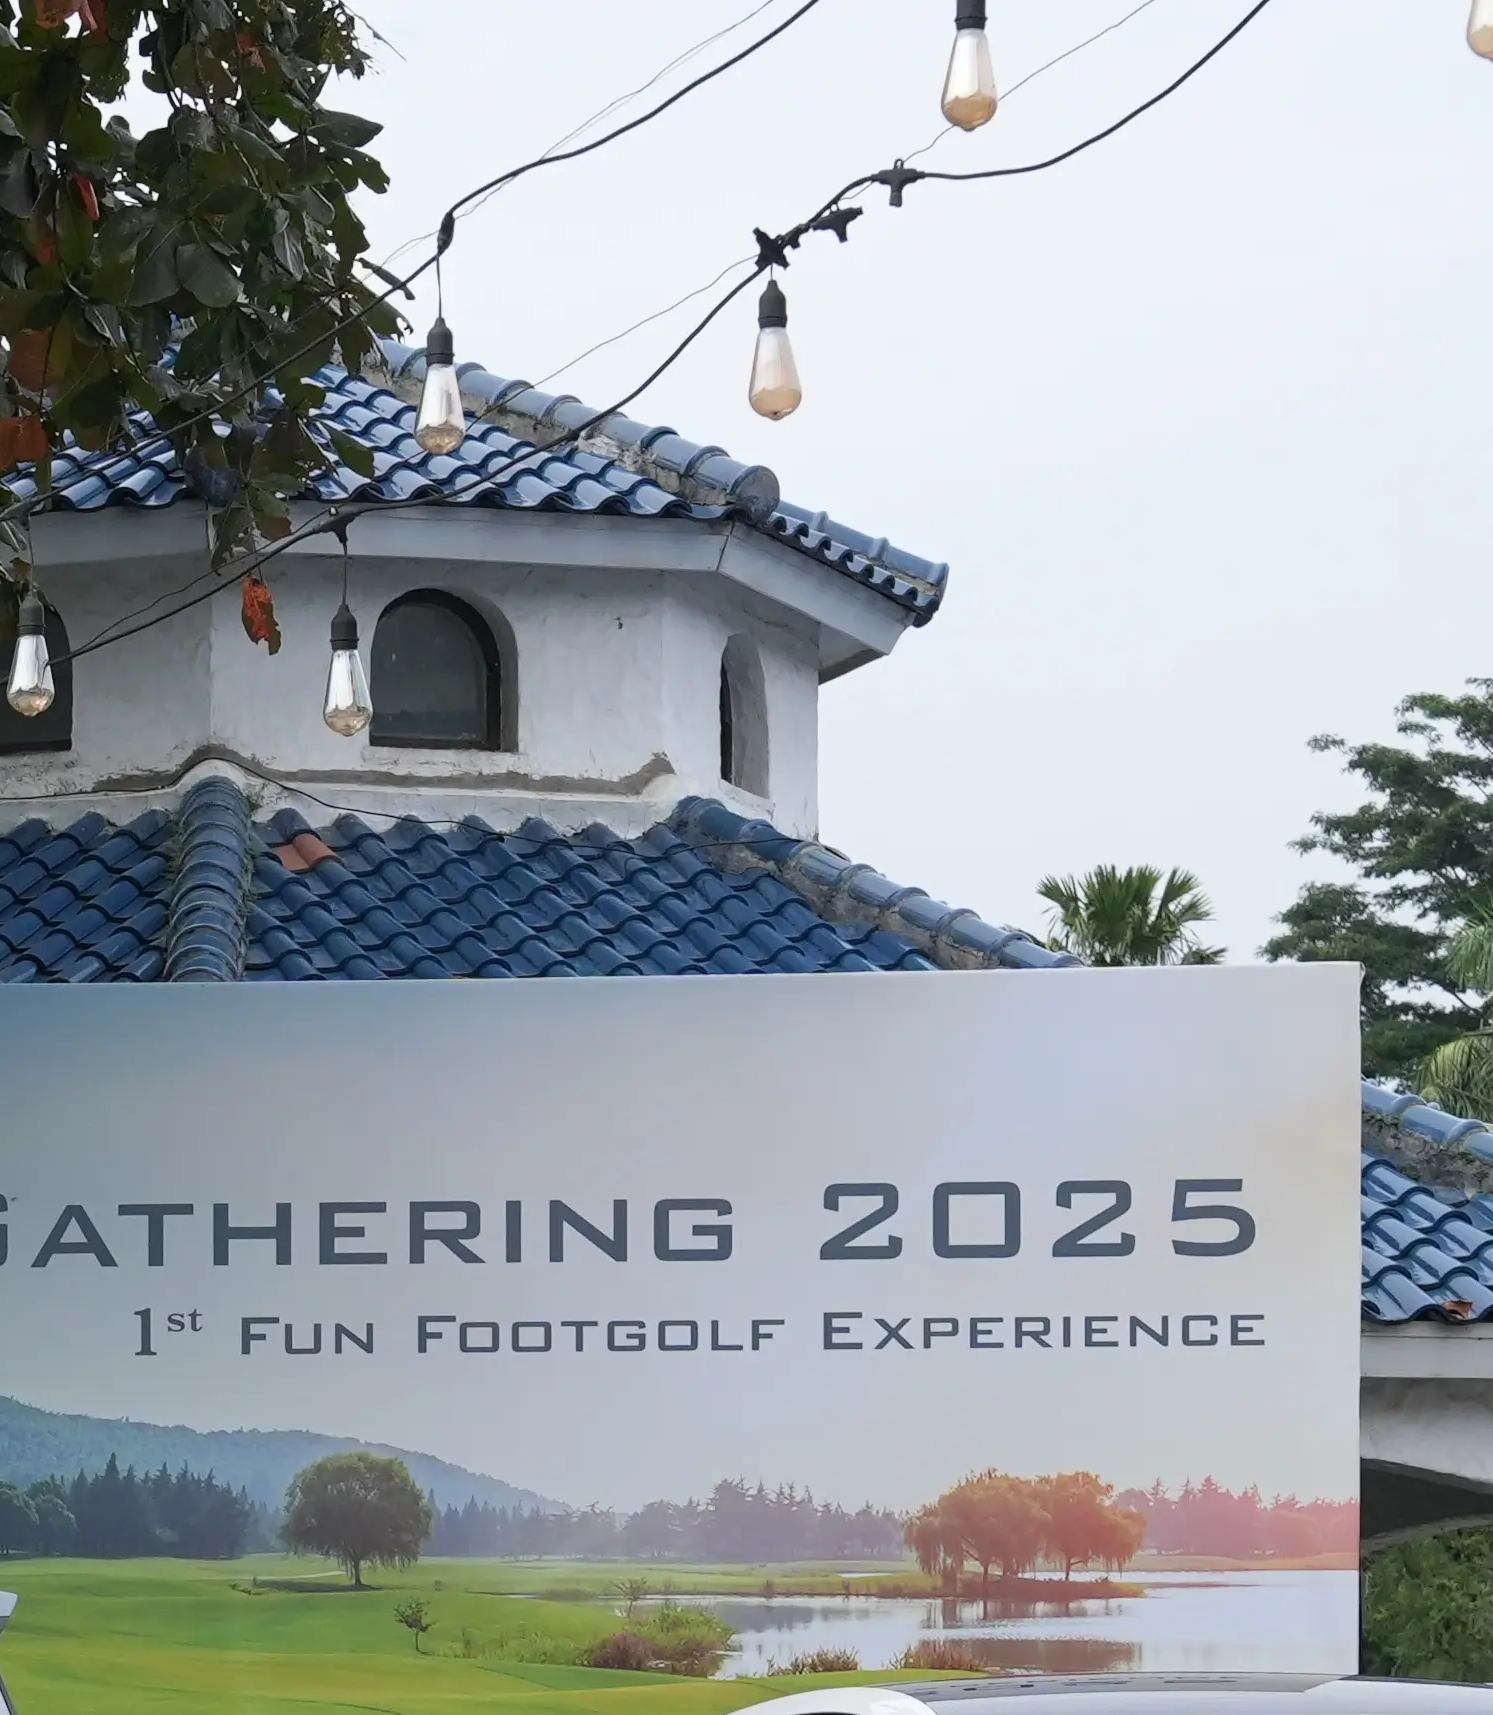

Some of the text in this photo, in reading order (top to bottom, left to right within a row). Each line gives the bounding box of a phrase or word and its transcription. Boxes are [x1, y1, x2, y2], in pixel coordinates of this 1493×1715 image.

[818, 1177, 1258, 1261] 2025
[132, 1306, 1267, 1357] 1st FUN FOOTGOLF EXPERIENCE
